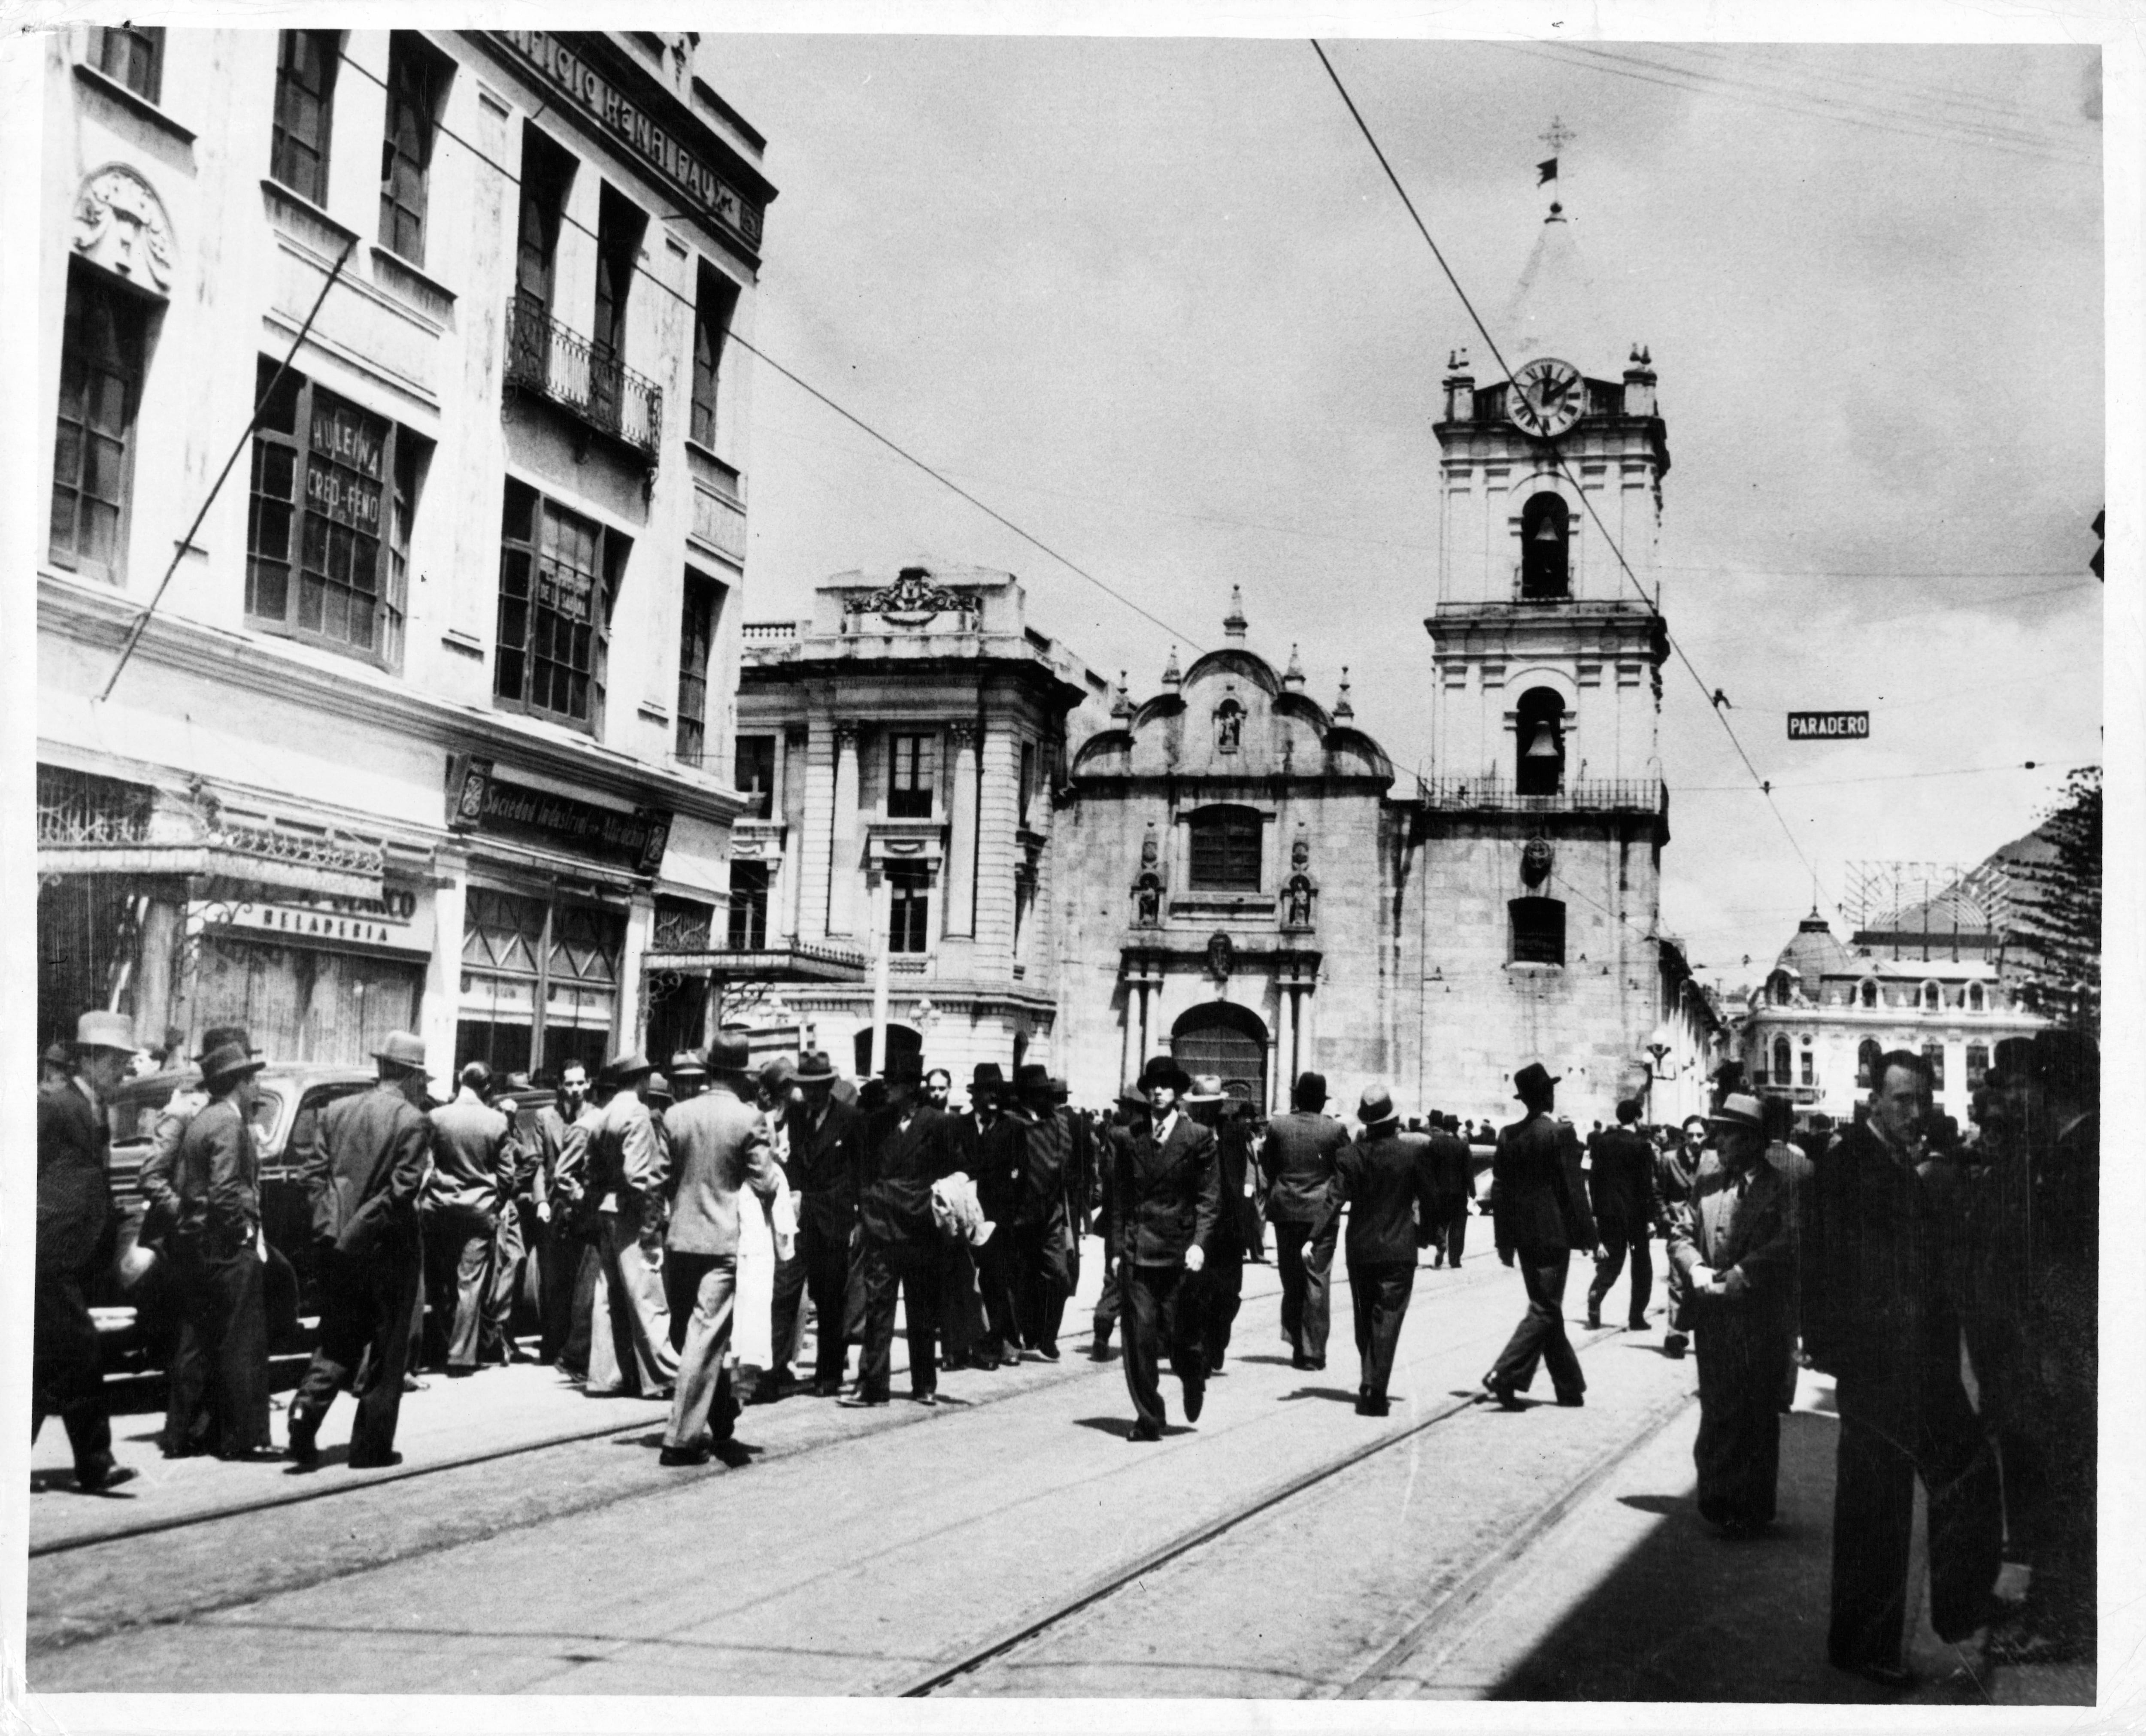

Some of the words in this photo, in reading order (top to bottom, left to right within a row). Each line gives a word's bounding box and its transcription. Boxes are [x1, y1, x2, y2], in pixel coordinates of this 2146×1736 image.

[603, 84, 669, 171] HENRI
[1790, 716, 1867, 736] PARADERO
[264, 909, 387, 942] HELADERIA
